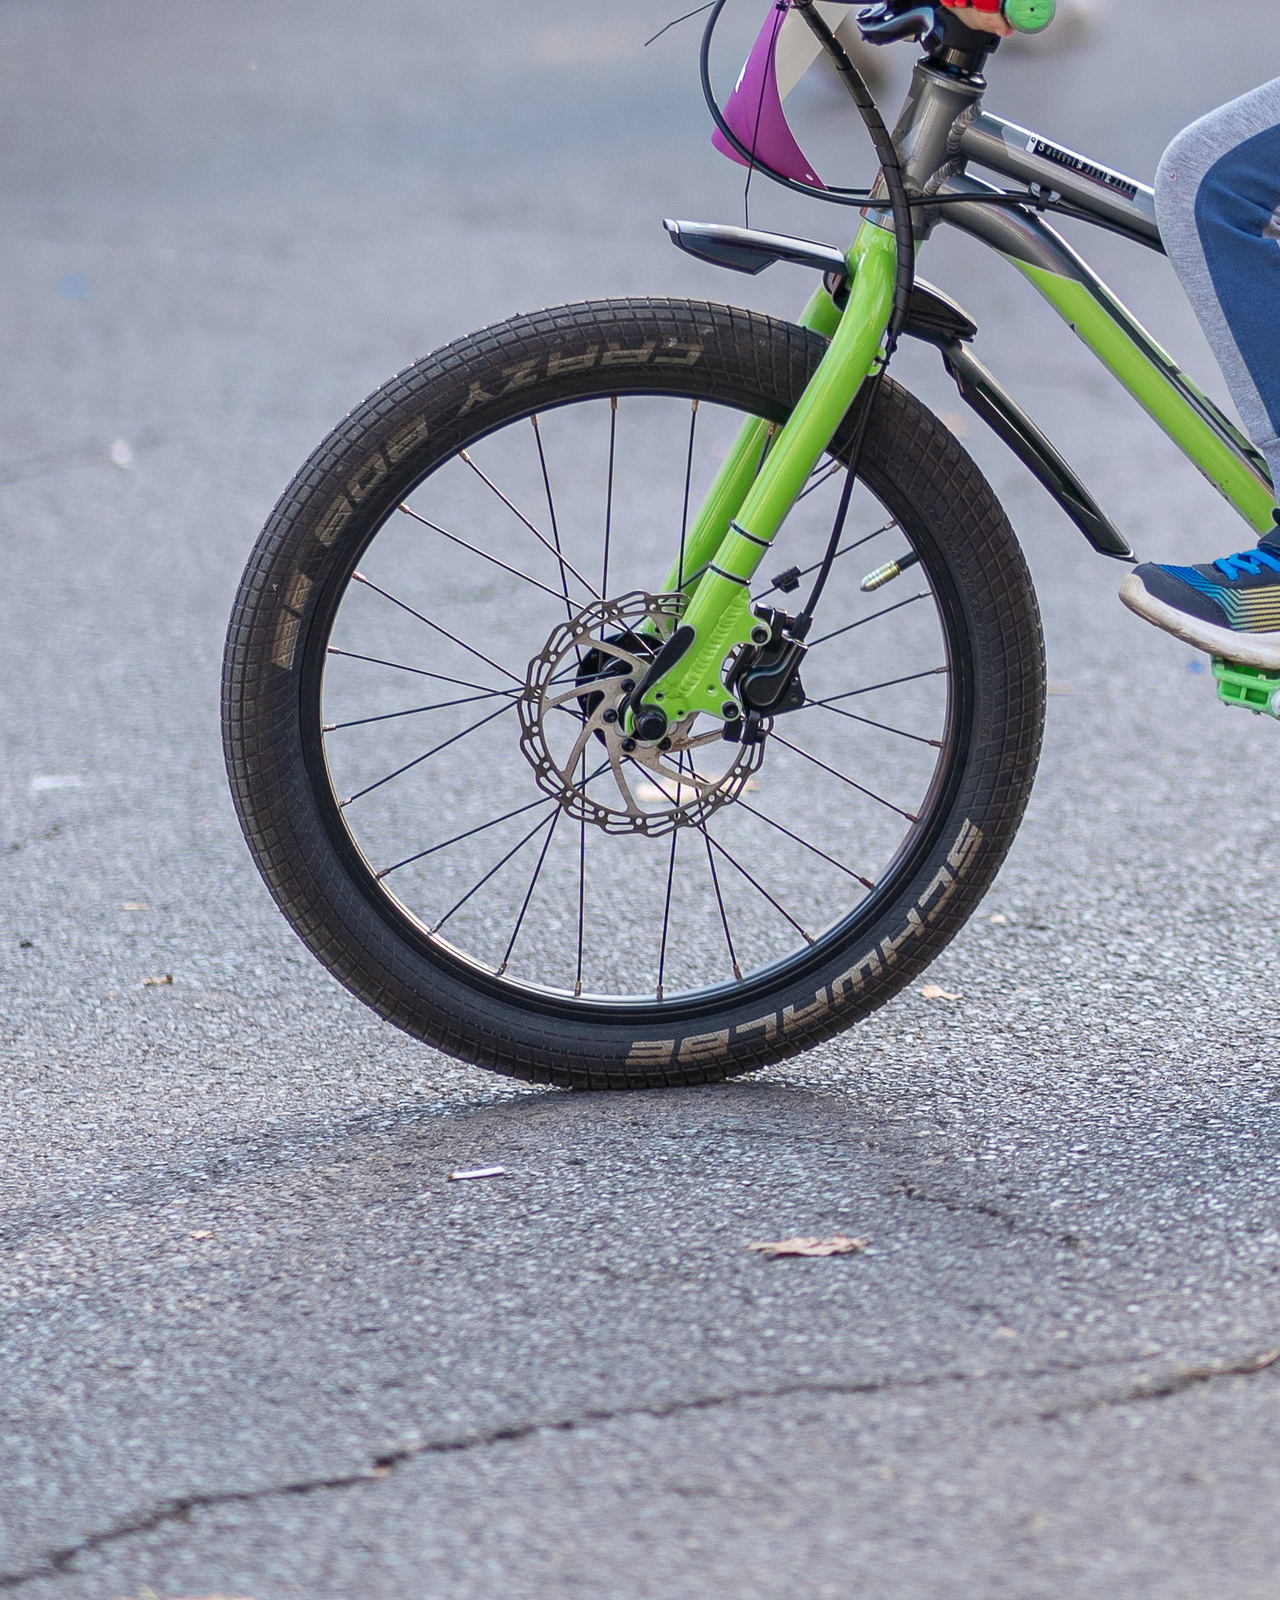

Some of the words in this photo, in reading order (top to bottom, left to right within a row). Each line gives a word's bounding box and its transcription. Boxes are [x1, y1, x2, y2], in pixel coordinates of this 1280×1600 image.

[456, 342, 703, 416] CRAZY
[315, 415, 428, 548] BOB
[625, 818, 984, 1066] SCHWALBE
